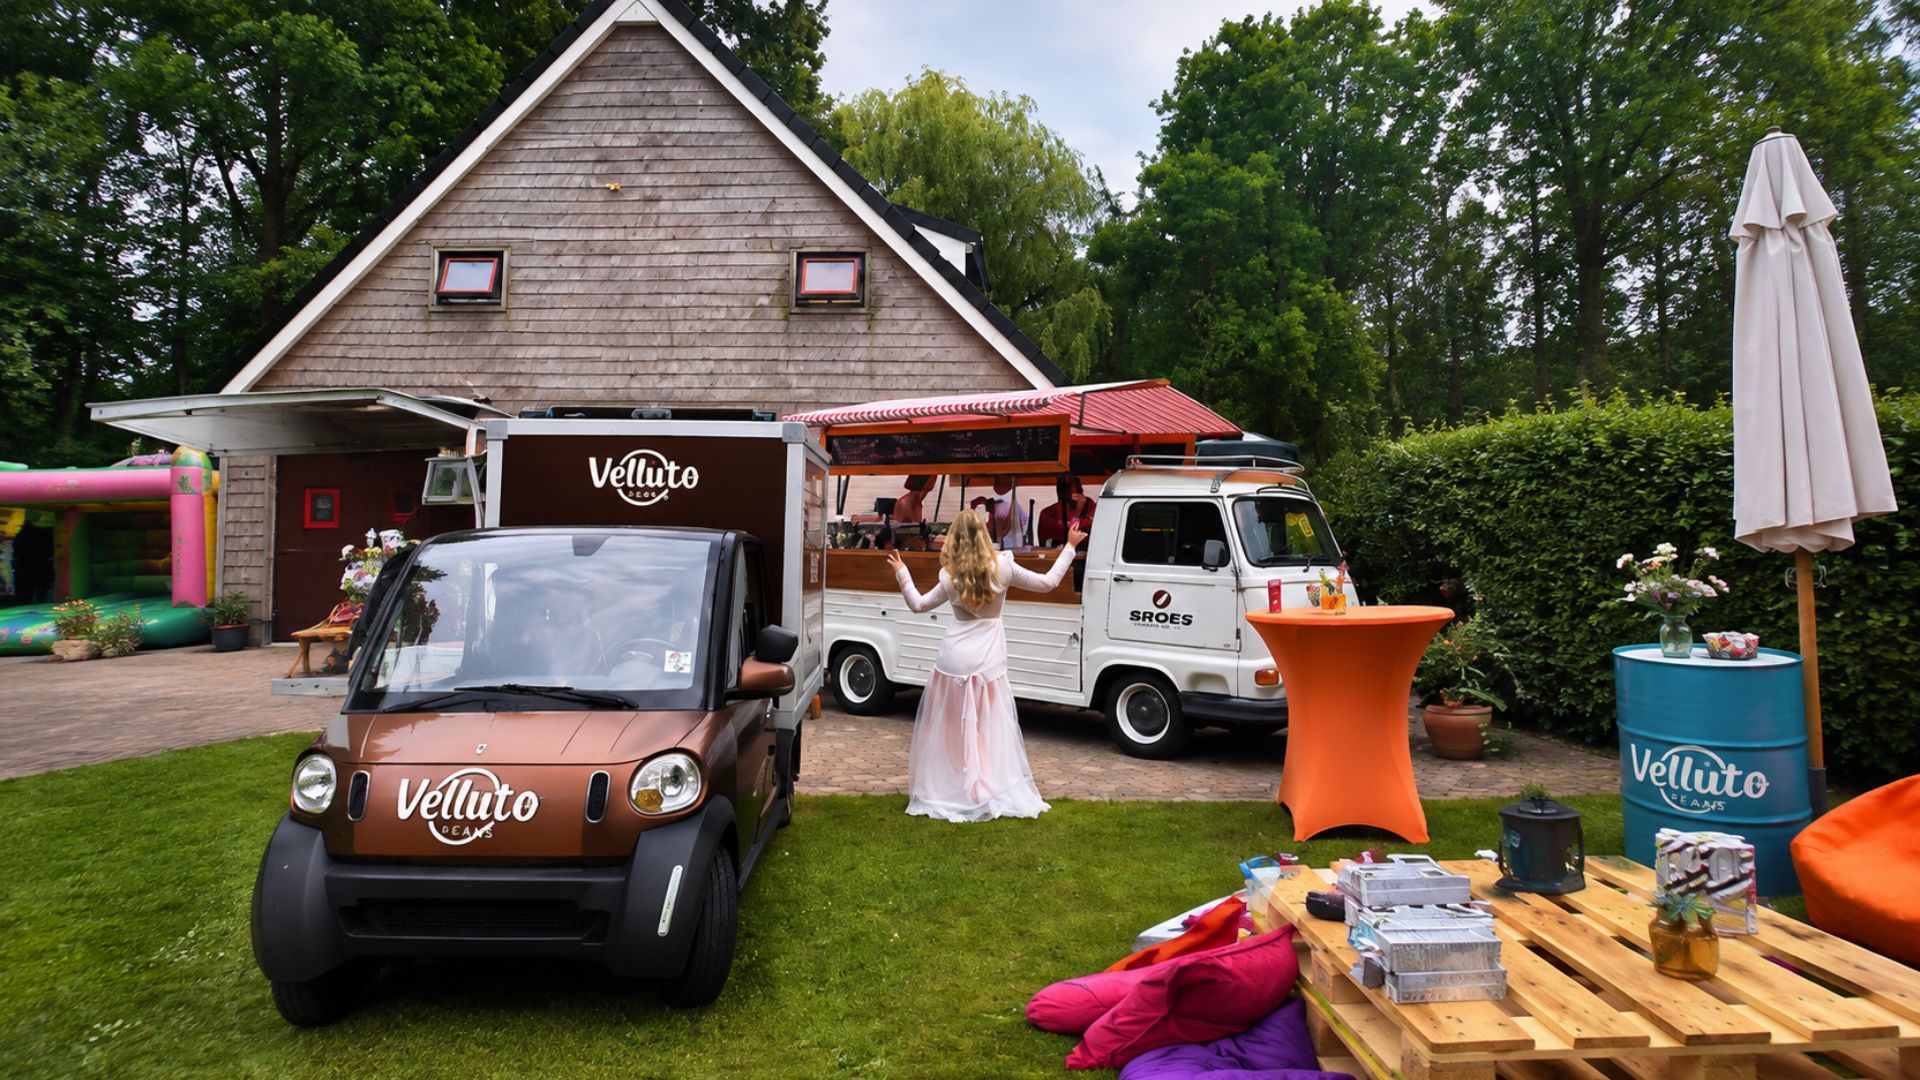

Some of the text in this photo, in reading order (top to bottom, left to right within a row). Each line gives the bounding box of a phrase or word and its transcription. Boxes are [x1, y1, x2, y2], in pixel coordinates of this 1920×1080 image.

[588, 456, 699, 489] Velluto
[1129, 610, 1193, 626] SROES
[1630, 743, 1770, 798] Velluto
[397, 778, 539, 822] Velluto
